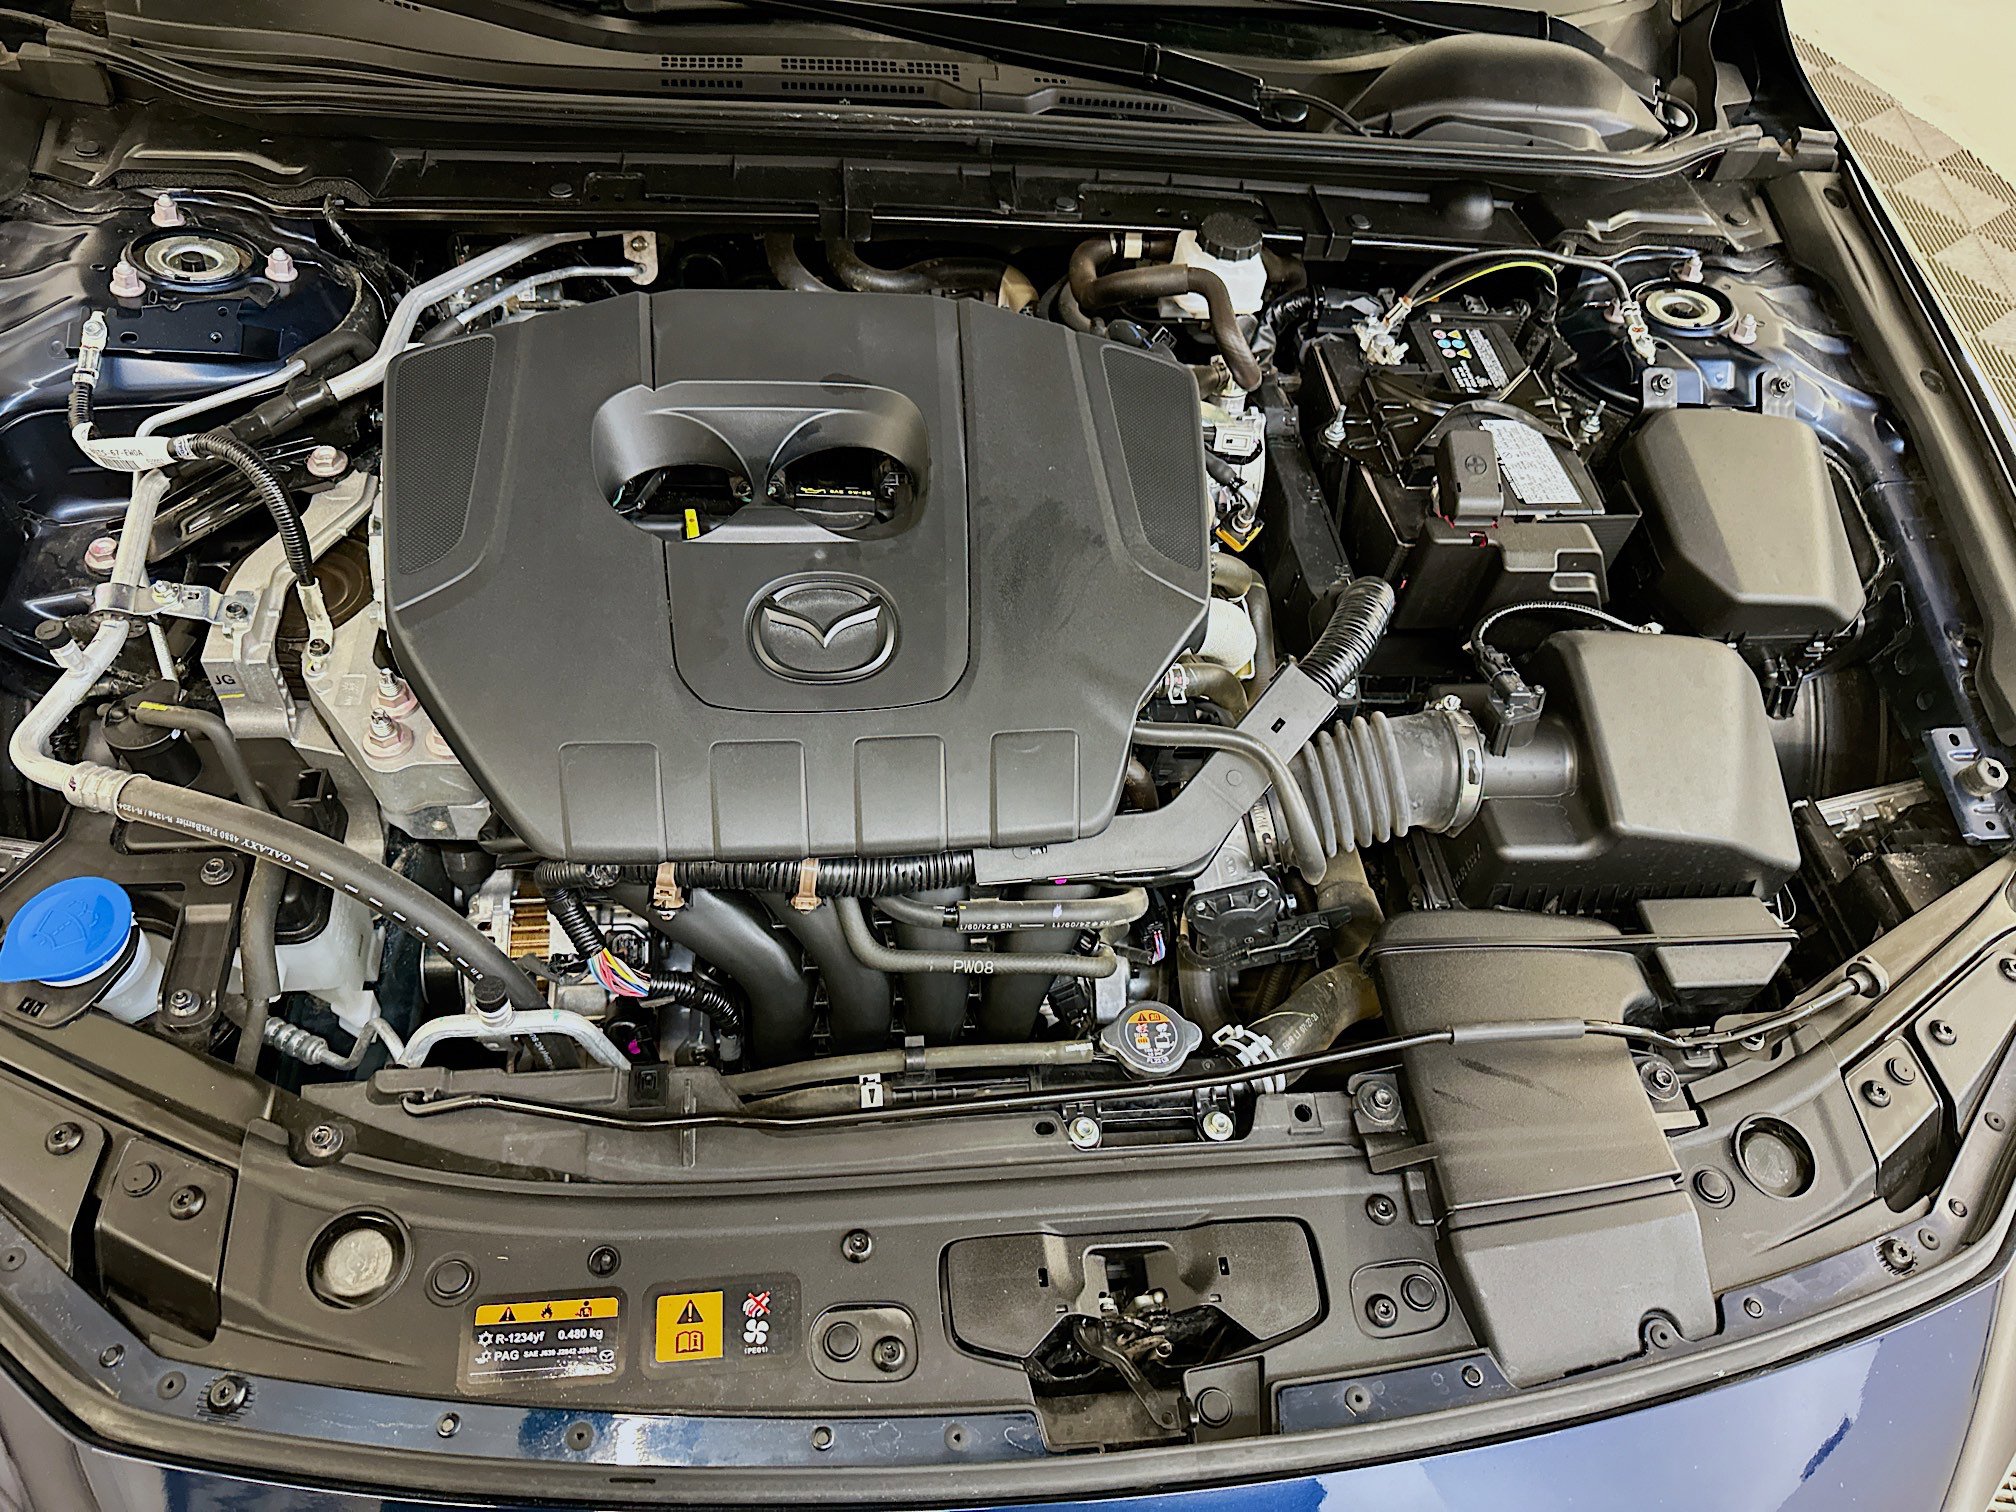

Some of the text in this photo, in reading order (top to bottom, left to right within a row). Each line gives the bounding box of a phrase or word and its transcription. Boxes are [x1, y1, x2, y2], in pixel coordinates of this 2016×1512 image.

[215, 674, 236, 685] JG
[176, 817, 218, 837] FlexBarrier
[219, 830, 239, 843] 4880
[241, 838, 292, 863] GALAXY
[953, 960, 994, 974] PW08
[495, 1327, 604, 1344] R-1234yf 0.480 kg
[493, 1350, 520, 1361] PAG
[523, 1350, 539, 1358] SAE
